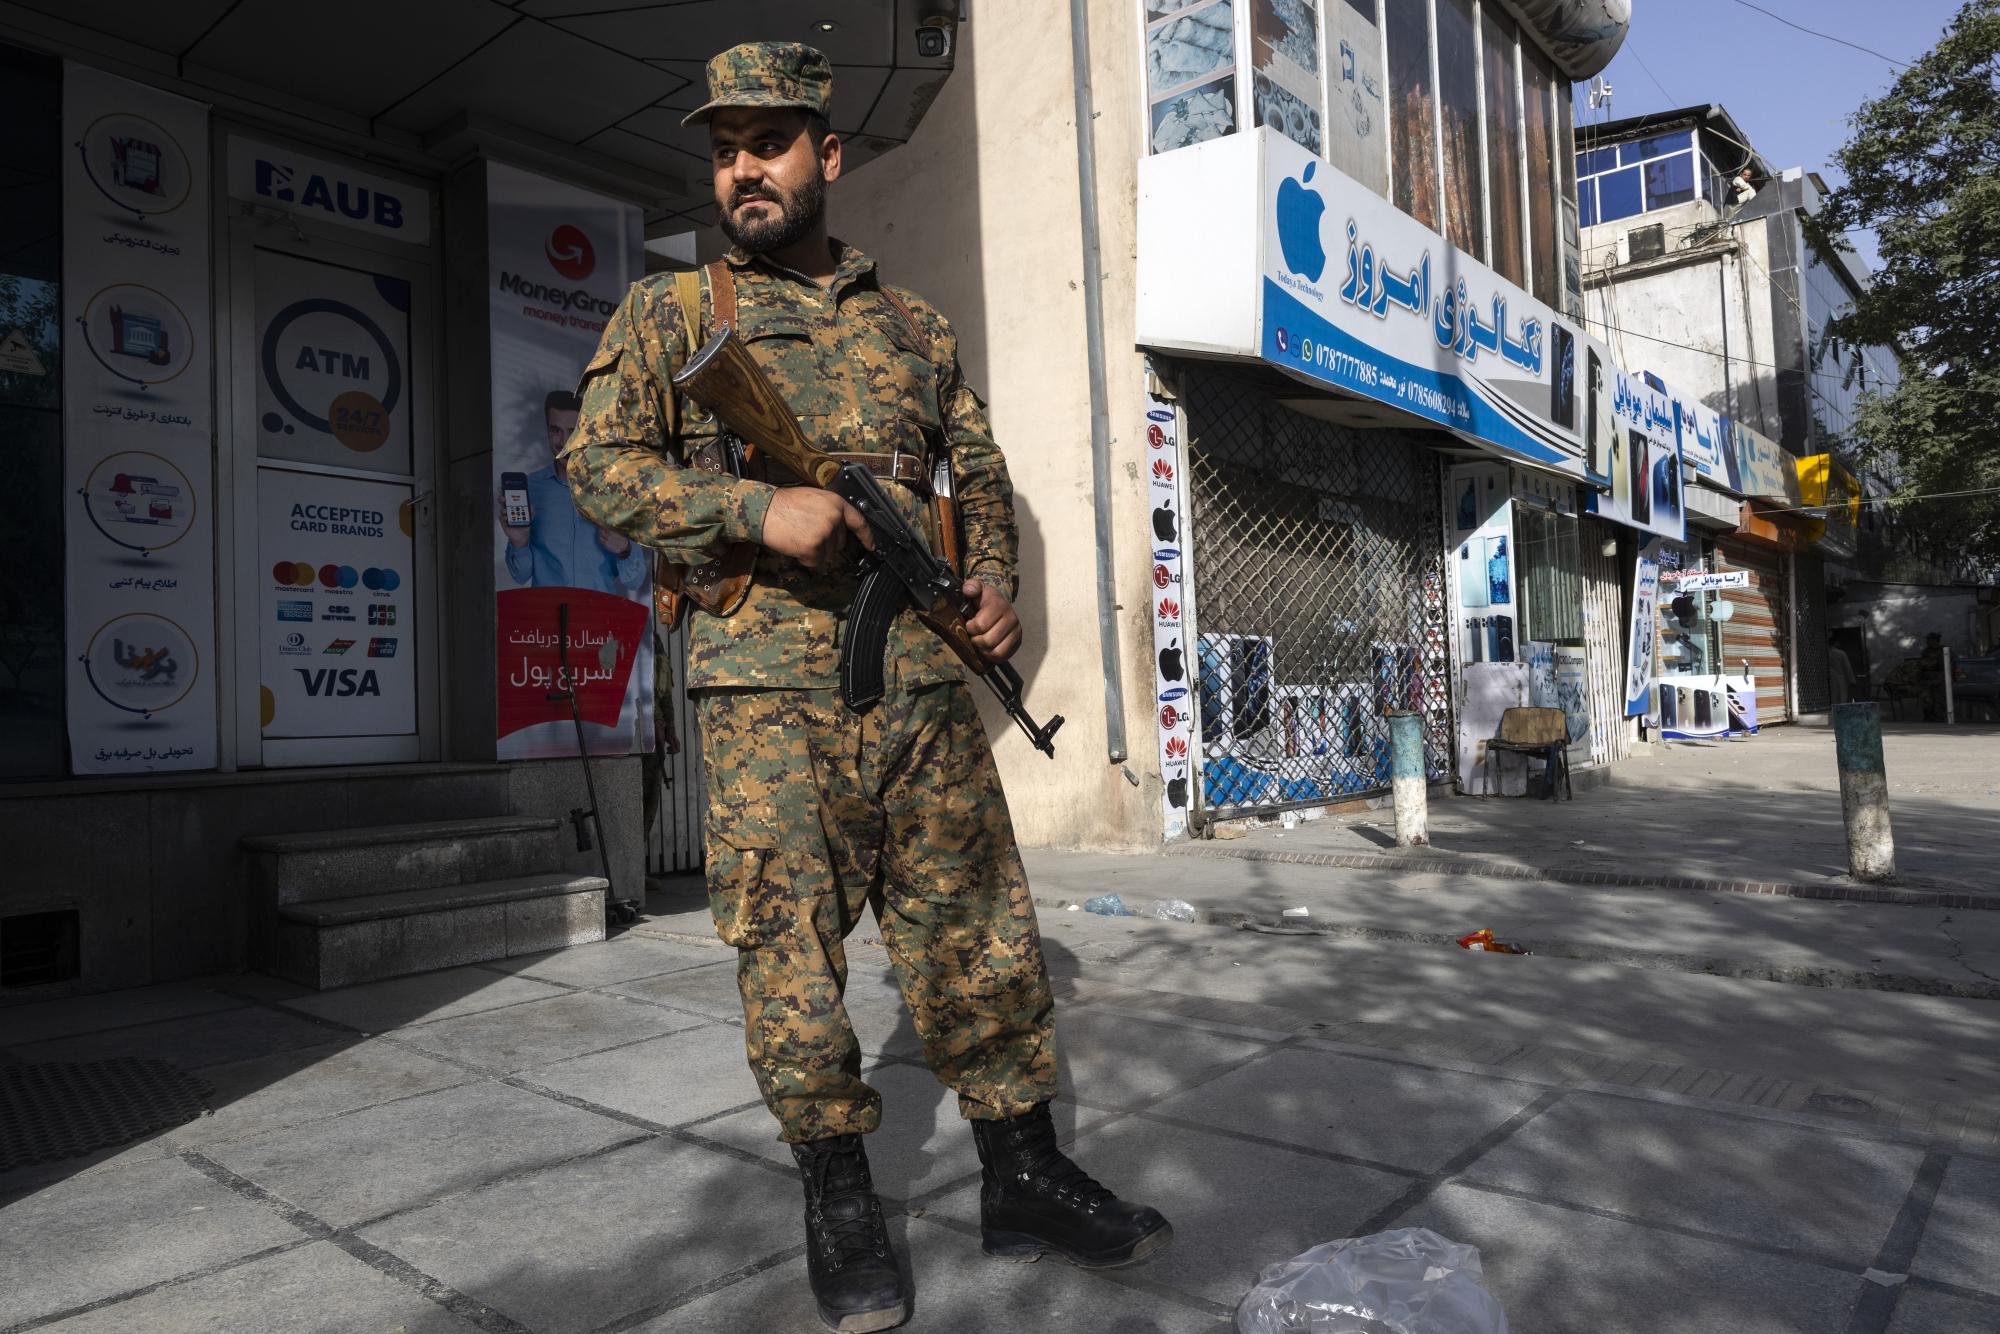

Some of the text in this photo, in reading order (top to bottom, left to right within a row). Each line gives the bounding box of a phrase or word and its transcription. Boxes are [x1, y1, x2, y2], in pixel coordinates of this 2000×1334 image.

[301, 174, 403, 229] AUB
[499, 271, 621, 317] MoneyGra
[1339, 219, 1542, 376] تکنالوژی امروز
[523, 305, 569, 327] money
[295, 346, 370, 381] ATM
[1316, 343, 1378, 387] 0787777885
[1407, 380, 1456, 418] 0785608294
[337, 407, 381, 427] 24/7
[1152, 480, 1175, 491] HUAWEI
[290, 503, 384, 525] ACCEPTED
[290, 519, 384, 538] CARD BRANDS
[1169, 573, 1181, 584] LG
[1700, 576, 1723, 586] موبایل
[1724, 572, 1745, 584] آریا
[274, 585, 314, 593] mastercard
[324, 588, 353, 596] maestro
[509, 628, 560, 648] دریافت
[293, 668, 381, 697] VISA
[510, 656, 614, 691] سریع پول
[1165, 759, 1188, 768] HUAWE
